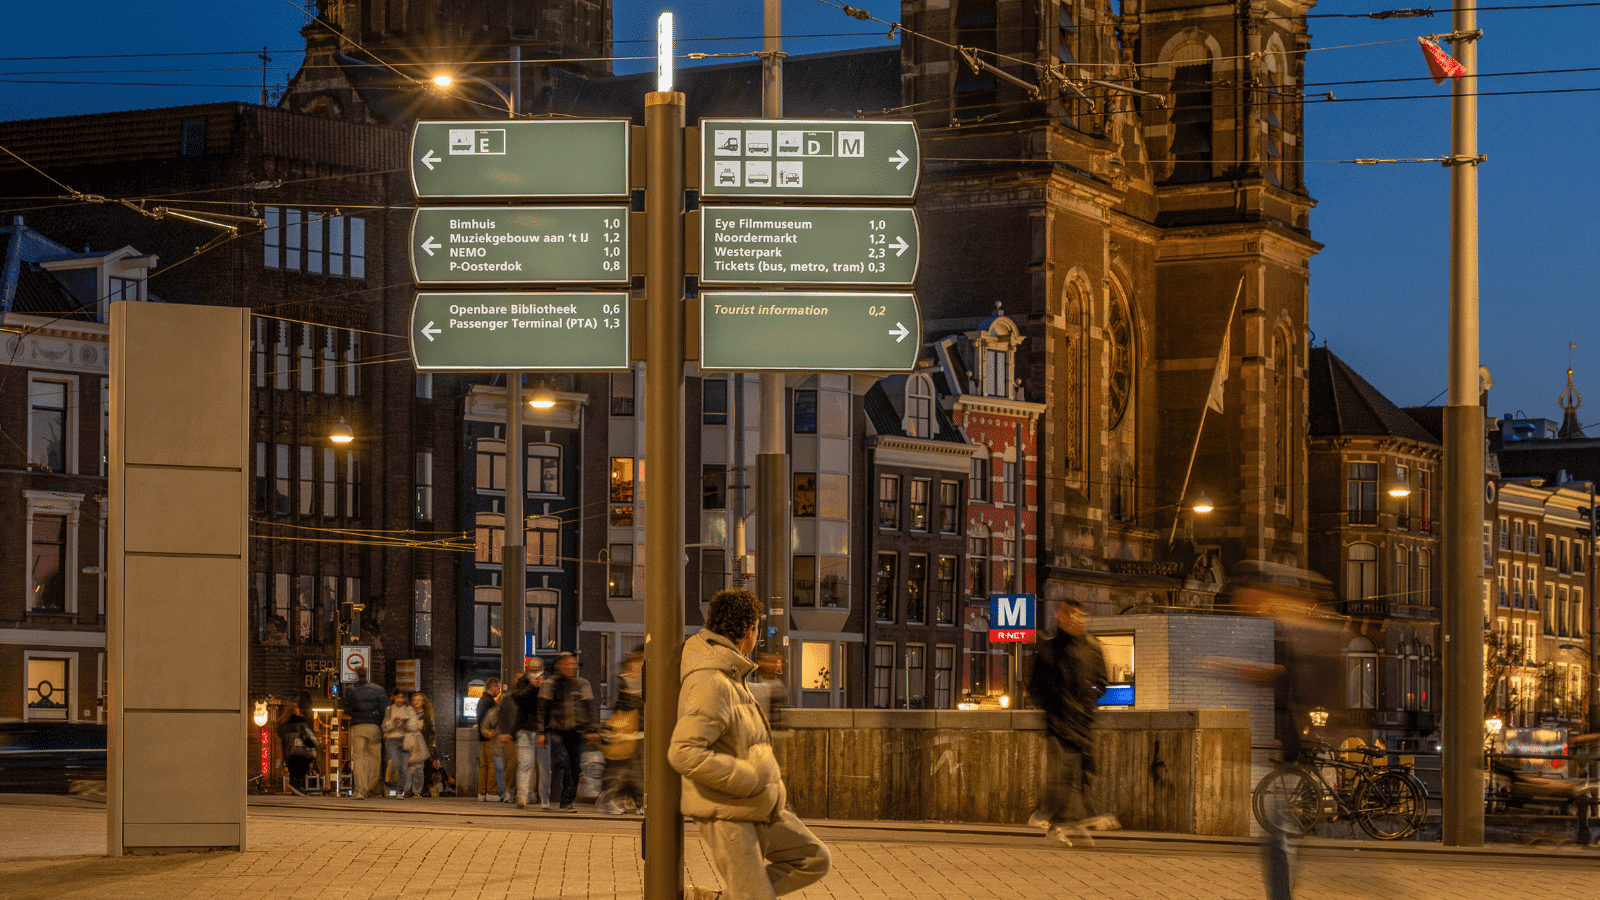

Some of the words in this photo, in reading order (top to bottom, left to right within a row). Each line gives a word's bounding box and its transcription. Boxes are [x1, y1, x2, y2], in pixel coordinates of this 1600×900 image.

[480, 138, 489, 152] E
[807, 140, 821, 154] D
[843, 138, 860, 155] M
[450, 219, 496, 229] Bimhuis
[603, 219, 620, 230] 1,0
[715, 219, 736, 231] Eye
[739, 219, 812, 229] Filmmuseum
[869, 220, 886, 231] 1,0
[450, 233, 540, 245] Muziekgebouw
[543, 235, 565, 243] aan
[580, 233, 589, 243] IJ
[603, 233, 620, 244] 1,2
[715, 233, 798, 244] Noordermarkt
[869, 234, 886, 245] 1,2
[450, 247, 487, 257] NEMO
[603, 247, 620, 258] 1,0
[714, 247, 782, 259] Westerpark
[868, 248, 886, 259] 2,3
[450, 261, 522, 271] P-Oosterdok
[603, 261, 621, 272] 0,8
[714, 261, 755, 272] Tickets
[758, 261, 787, 274] (bus,
[790, 262, 829, 274] metro,
[832, 261, 865, 273] tram)
[868, 262, 886, 273] 0,3
[449, 304, 507, 317] Openbare
[511, 304, 577, 315] Bibliotheek
[603, 304, 620, 315] 0,6
[714, 304, 755, 315] Tourist
[758, 304, 828, 316] information
[868, 306, 886, 317] 0,2
[450, 318, 508, 331] Passenger
[512, 318, 563, 329] Terminal
[566, 318, 598, 330] (PTA)
[603, 318, 620, 330] 1,3
[998, 597, 1027, 626] M
